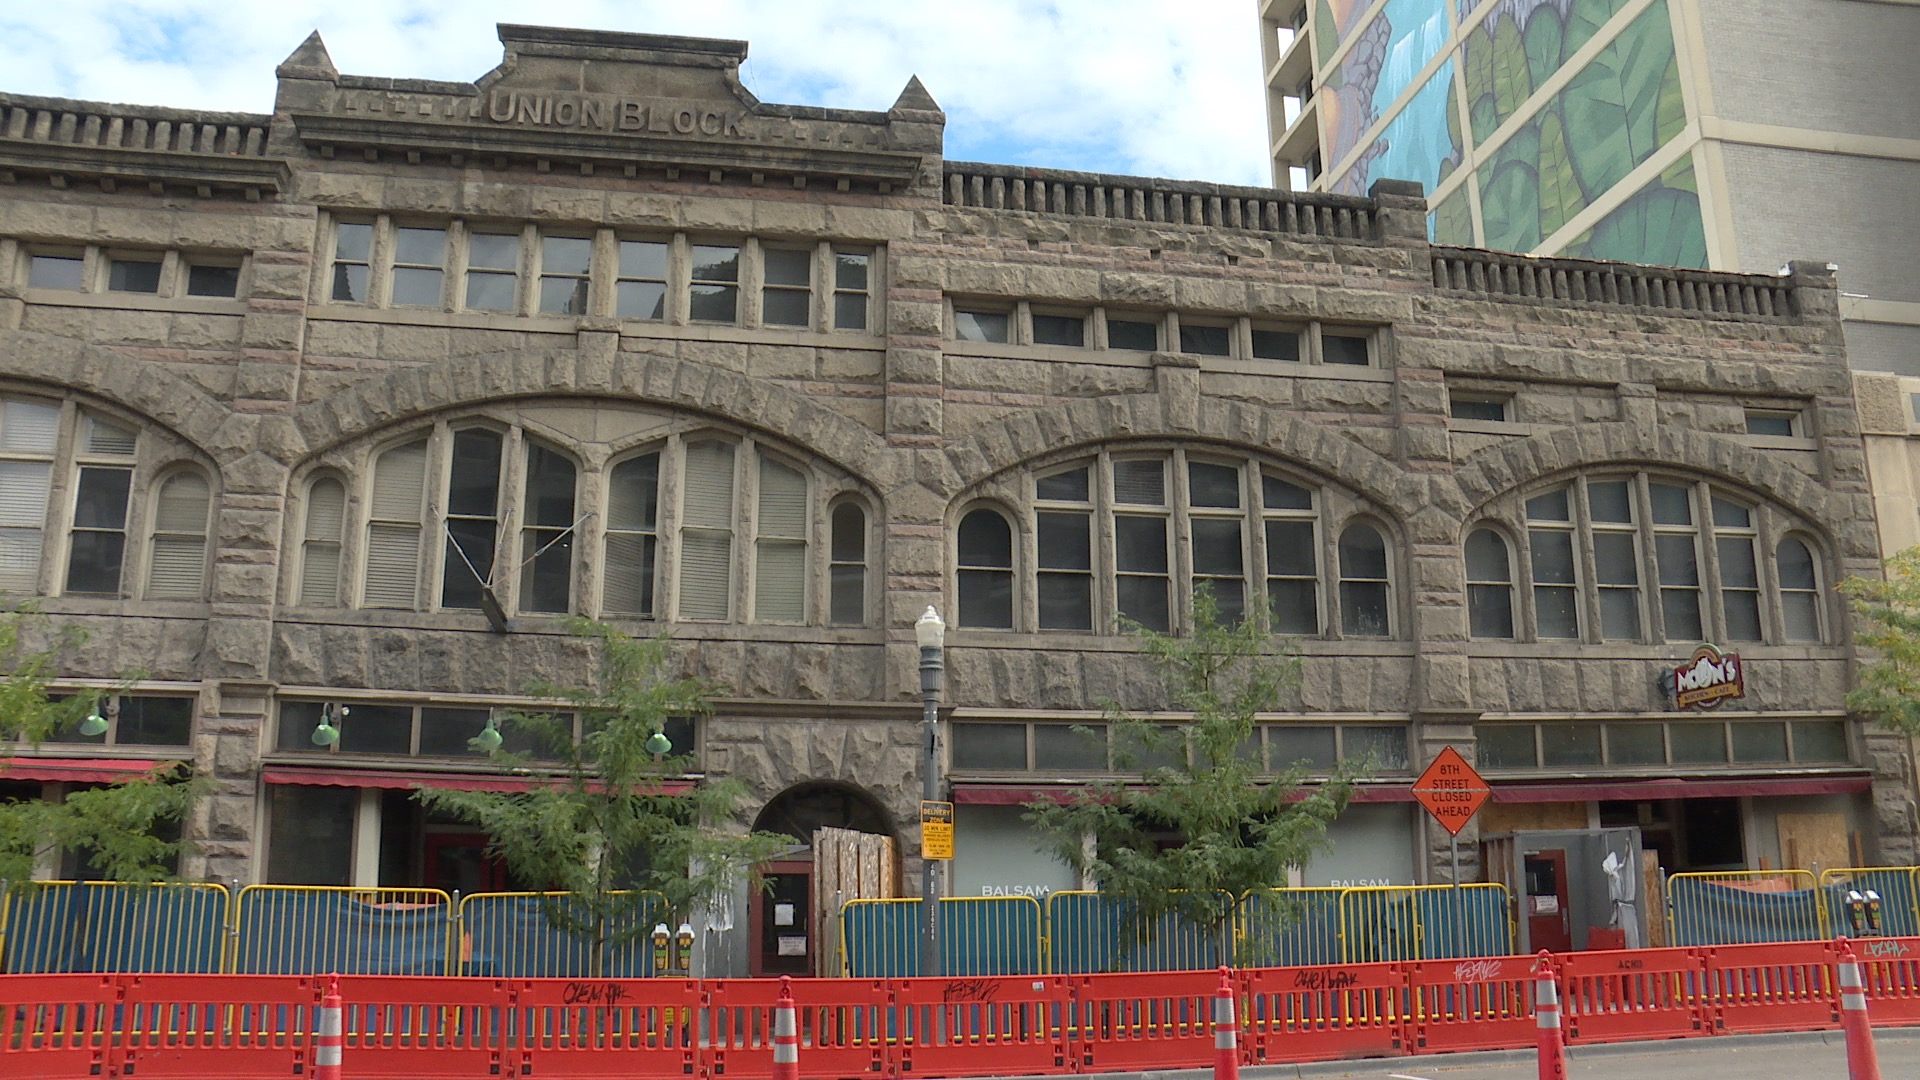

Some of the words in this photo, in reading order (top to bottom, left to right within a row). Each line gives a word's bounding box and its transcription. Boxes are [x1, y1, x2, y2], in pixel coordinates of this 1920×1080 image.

[488, 89, 602, 128] UNION
[618, 99, 746, 138] BLOCK
[1440, 764, 1460, 775] 8TH
[1432, 779, 1469, 790] STREET
[1431, 791, 1472, 802] CLOSED
[923, 808, 951, 816] DELIVERY
[1435, 806, 1471, 817] AHEAD
[981, 884, 1049, 897] BALSAM
[1554, 1047, 1563, 1080] AC
